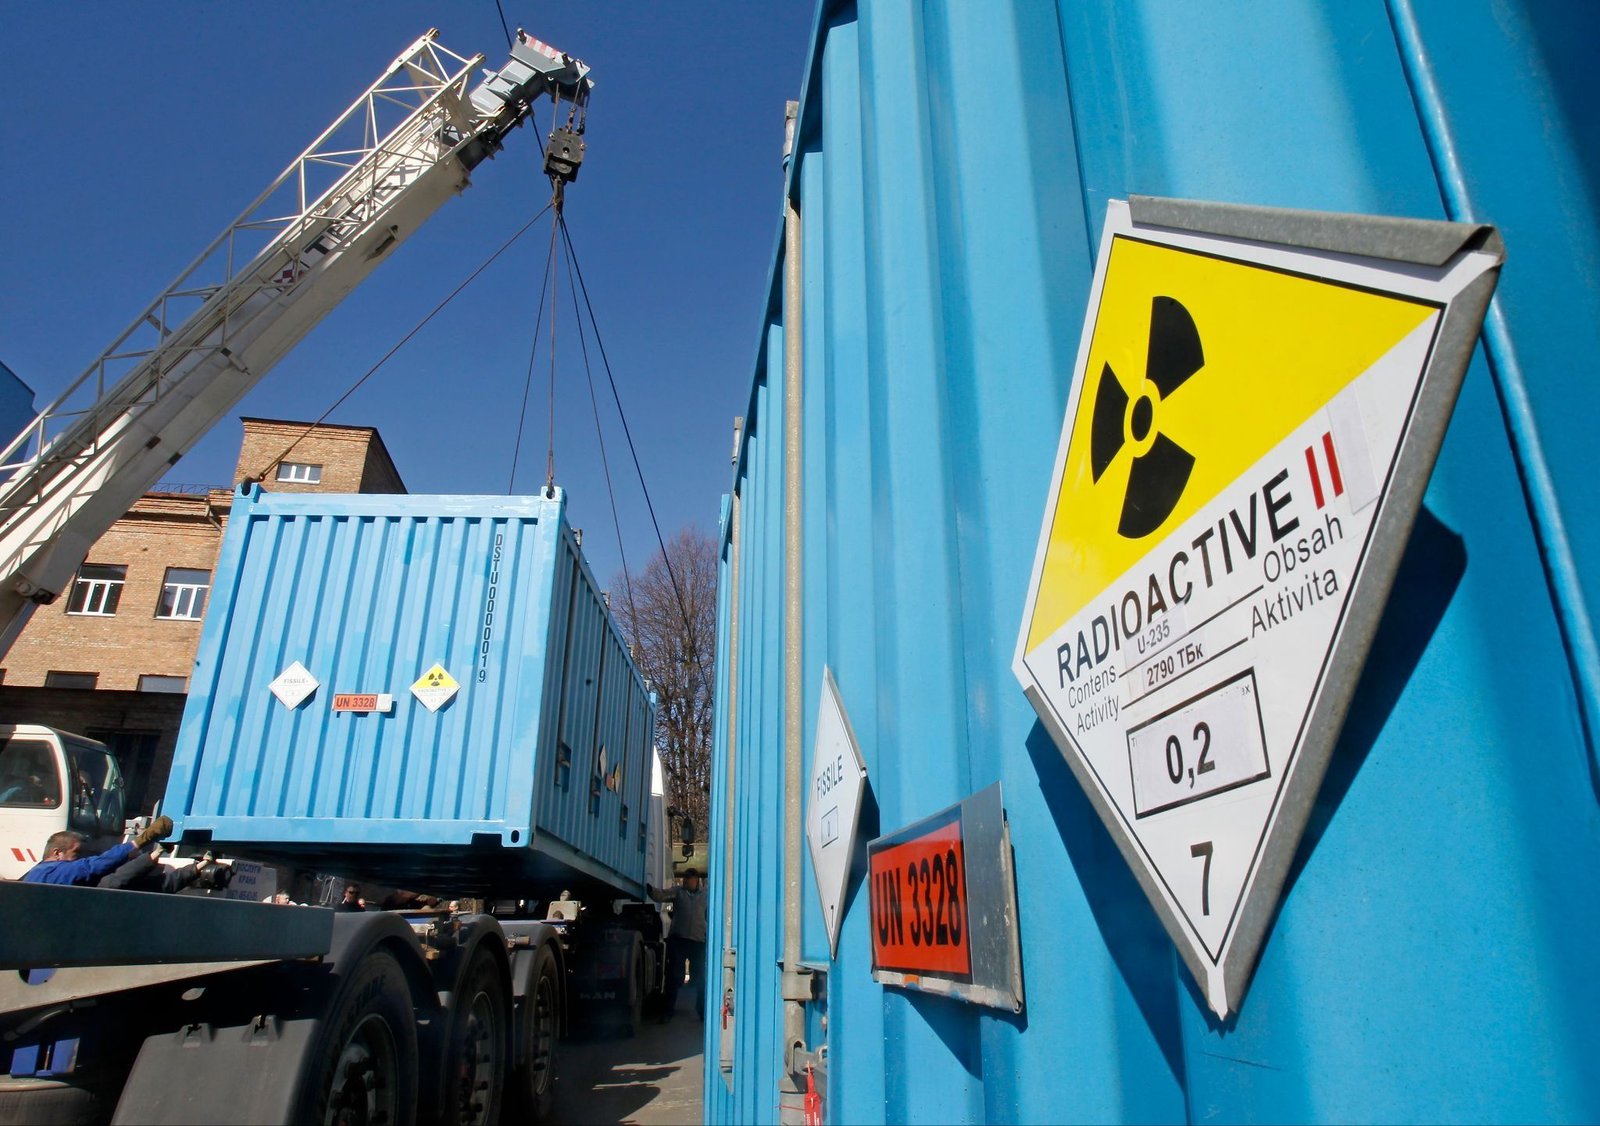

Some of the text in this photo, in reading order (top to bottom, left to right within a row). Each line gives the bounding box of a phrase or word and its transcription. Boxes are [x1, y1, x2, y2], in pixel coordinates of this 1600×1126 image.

[1057, 431, 1344, 689] RADIOACTIVE II
[1263, 513, 1343, 583] Obsah
[1249, 567, 1340, 639] Aktivita
[1136, 619, 1171, 655] U-235
[283, 677, 306, 685] FISSILE
[1068, 664, 1117, 709] Contens
[1146, 655, 1175, 687] 2790
[336, 697, 375, 708] UN 3328
[1076, 693, 1121, 736] Activity
[816, 754, 843, 802] FISSILE
[1165, 721, 1216, 789] 0,2
[875, 848, 962, 947] UN 3328
[1190, 840, 1214, 916] 7
